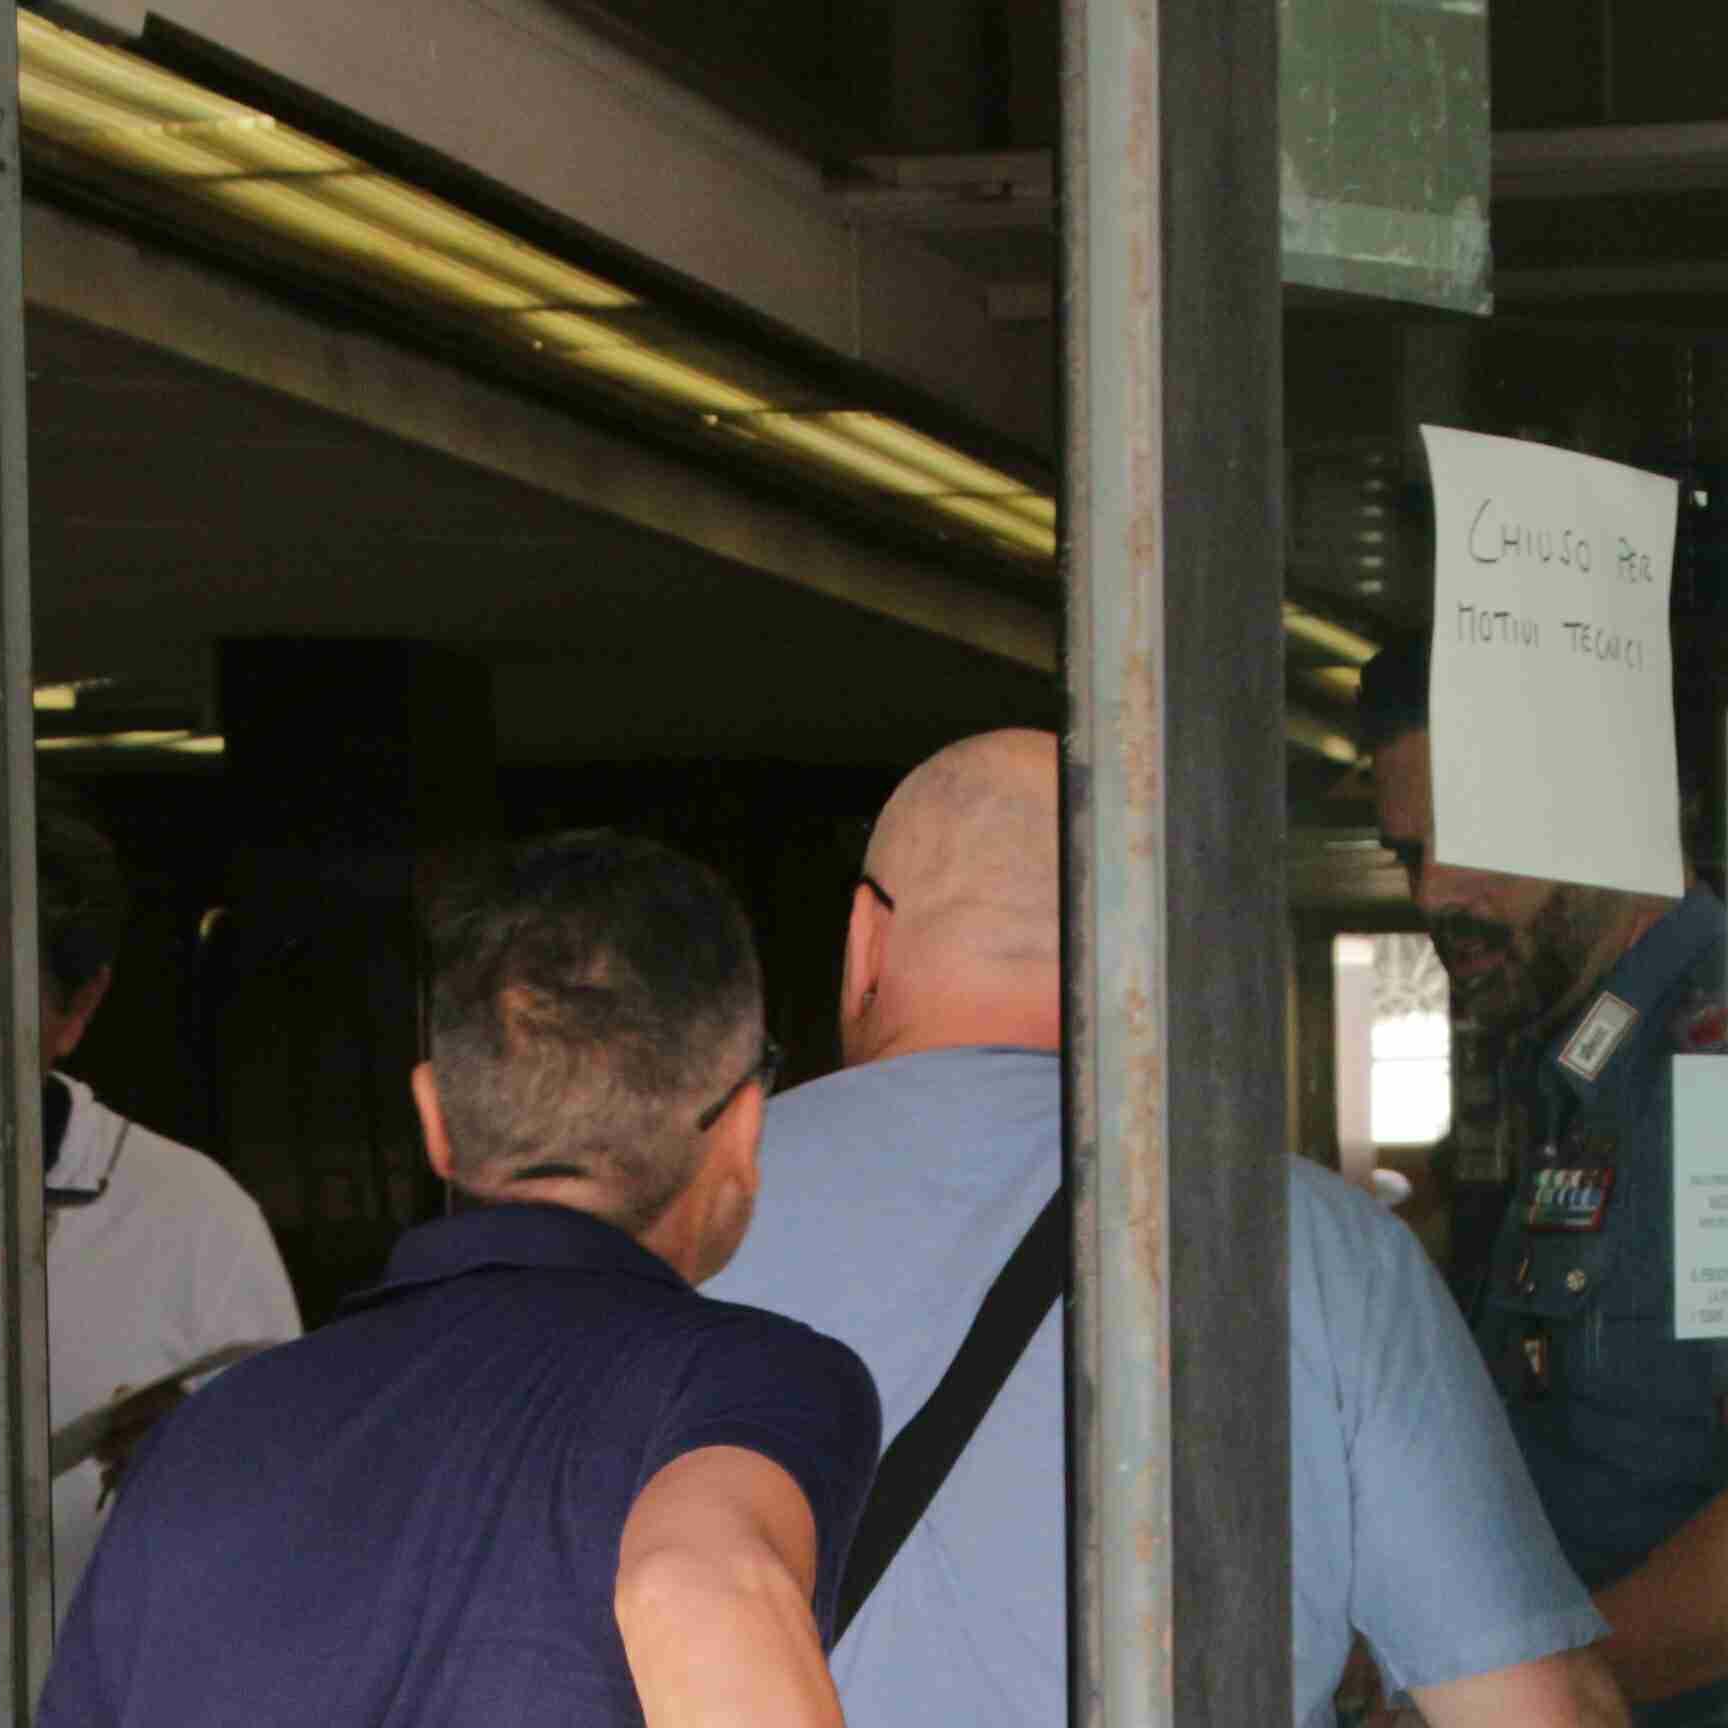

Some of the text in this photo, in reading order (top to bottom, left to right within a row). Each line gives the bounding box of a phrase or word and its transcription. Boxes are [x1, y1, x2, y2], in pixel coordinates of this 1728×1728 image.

[1468, 498, 1654, 584] CHIUSO PER
[1562, 621, 1644, 672] TECNICI
